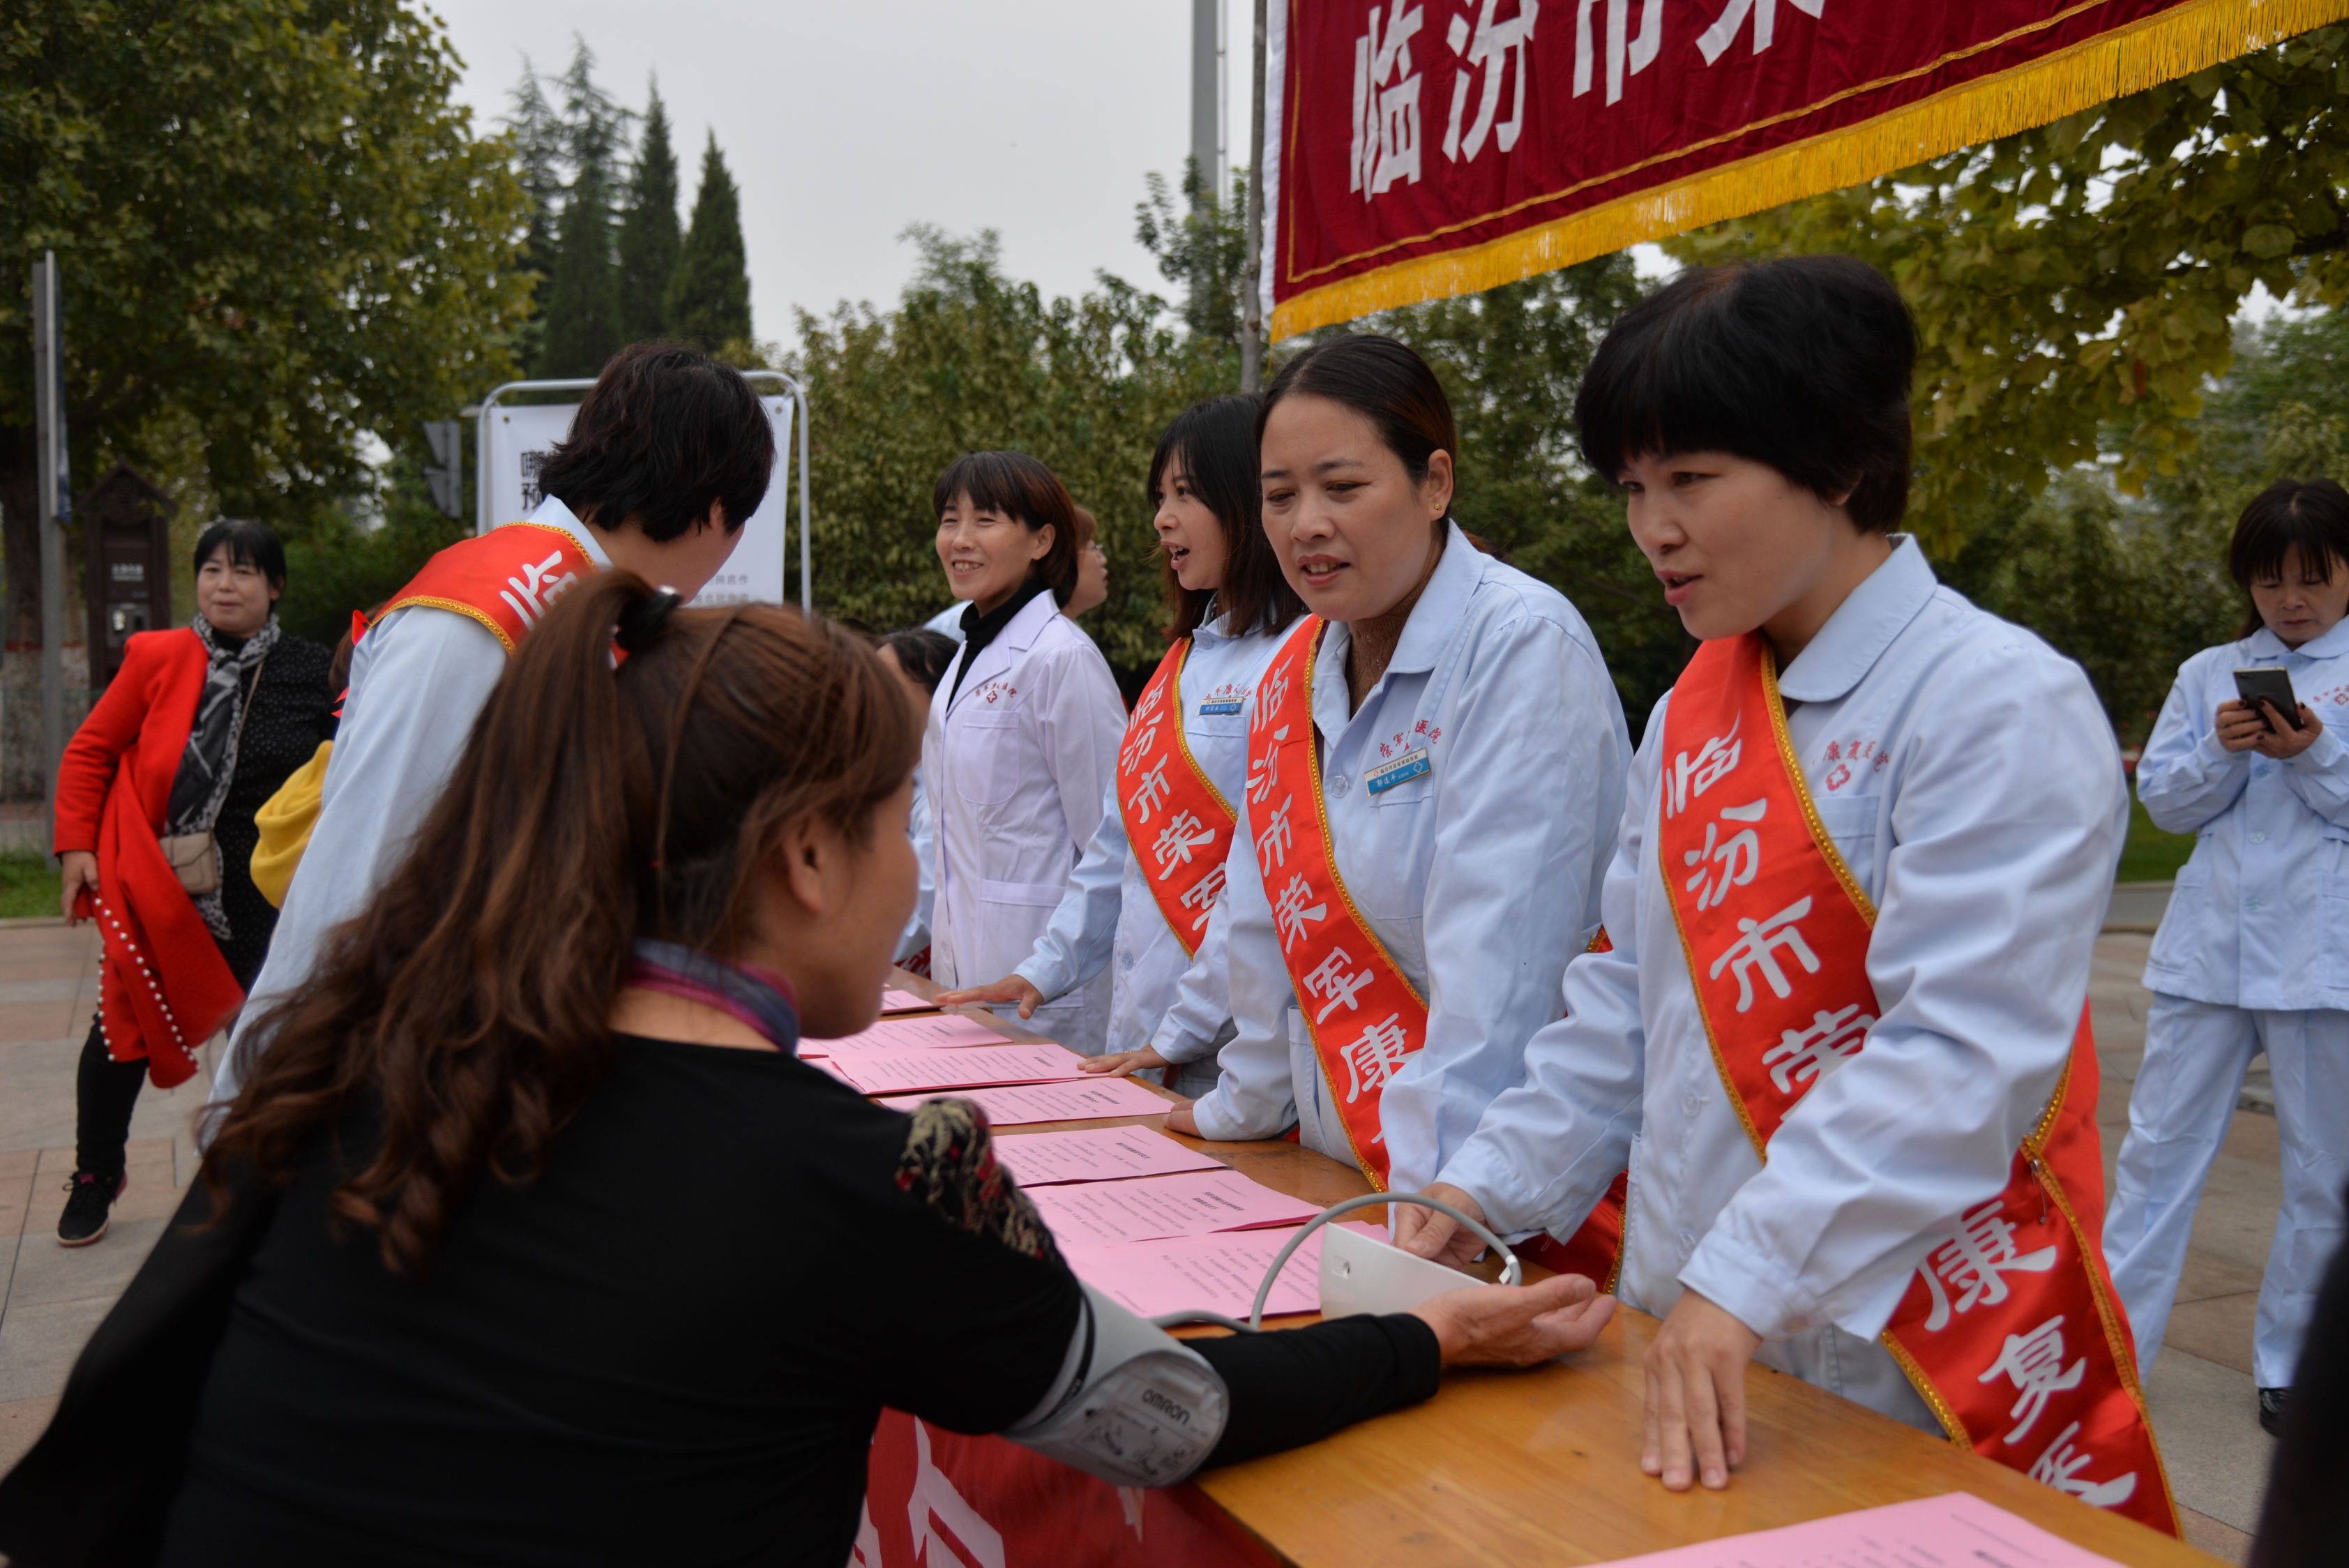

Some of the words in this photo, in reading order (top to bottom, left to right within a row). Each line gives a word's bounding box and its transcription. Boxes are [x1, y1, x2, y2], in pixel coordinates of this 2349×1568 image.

[1245, 654, 1424, 1145] 临汾市荣军康
